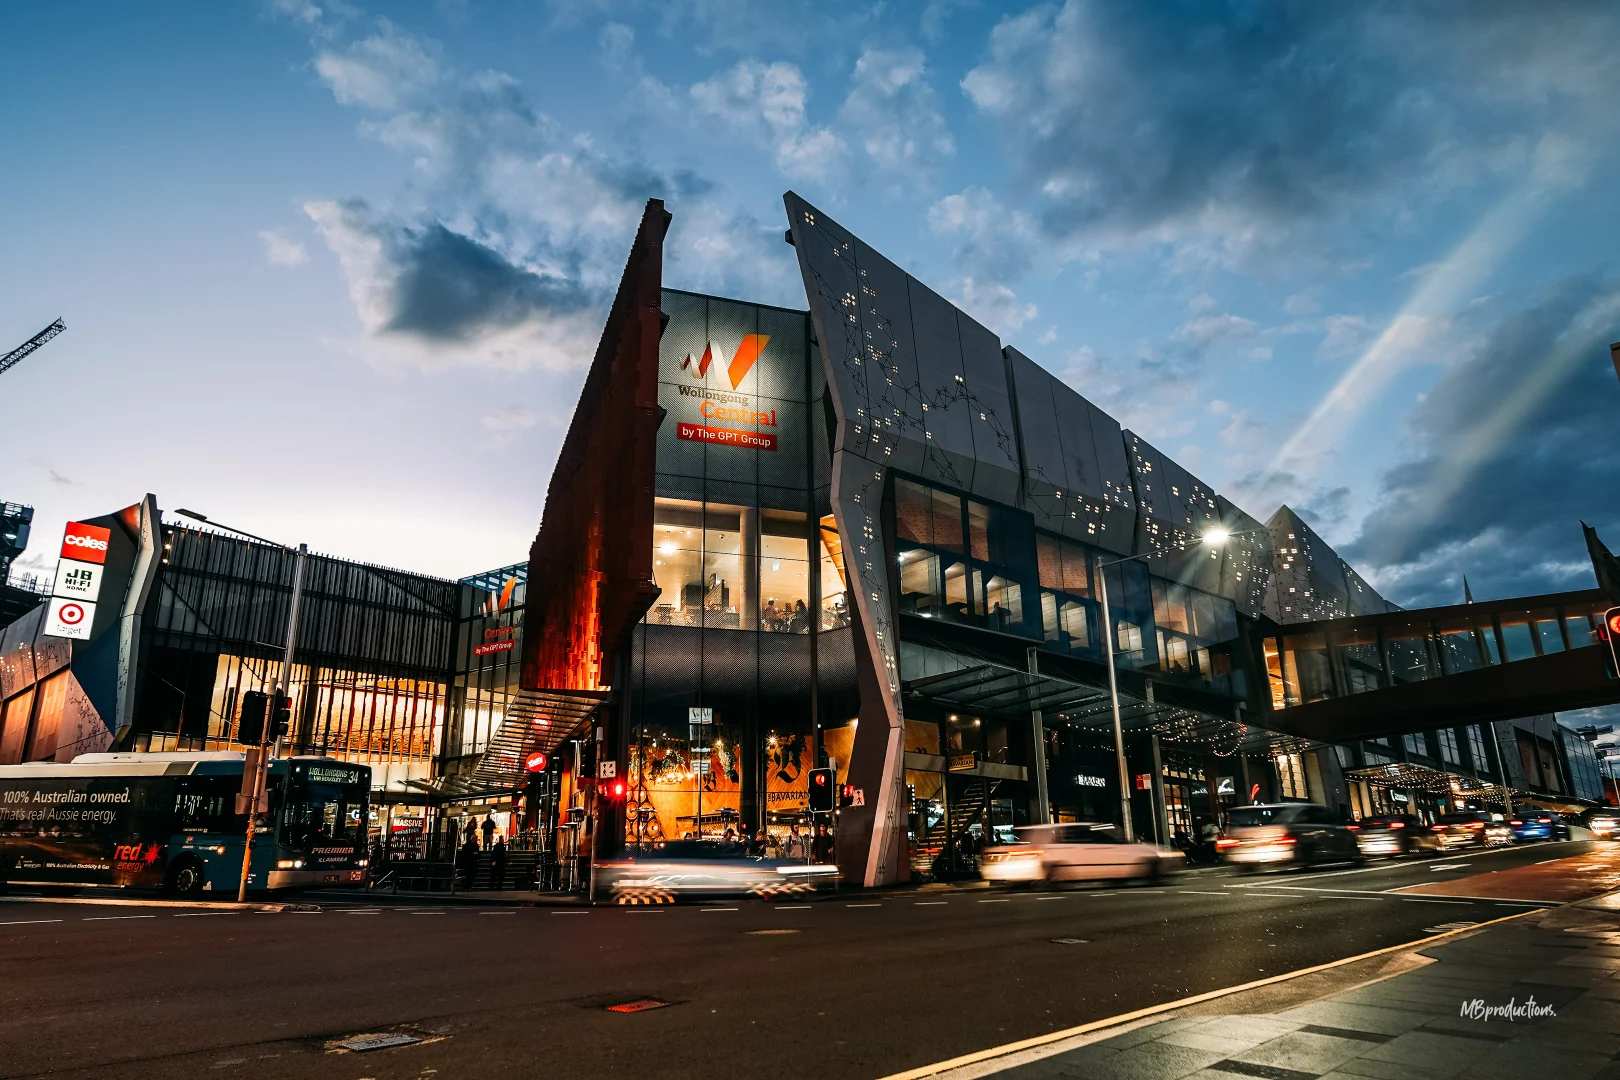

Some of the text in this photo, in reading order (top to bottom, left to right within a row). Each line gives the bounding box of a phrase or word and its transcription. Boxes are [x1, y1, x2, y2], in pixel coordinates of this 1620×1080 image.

[678, 385, 749, 406] Wollongong
[700, 401, 777, 427] Central
[682, 427, 771, 448] by The GPT Group
[65, 534, 108, 551] coles
[67, 569, 93, 581] JB
[66, 585, 87, 593] HOME
[499, 642, 512, 650] Group
[348, 770, 359, 784] 34
[3, 789, 131, 804] 100% Australian owned.
[771, 790, 809, 802] BAVARIAN
[0, 806, 117, 825] That's real Aussie energy.
[393, 818, 423, 828] MASSIVE
[113, 843, 143, 861] red
[117, 861, 145, 873] energy
